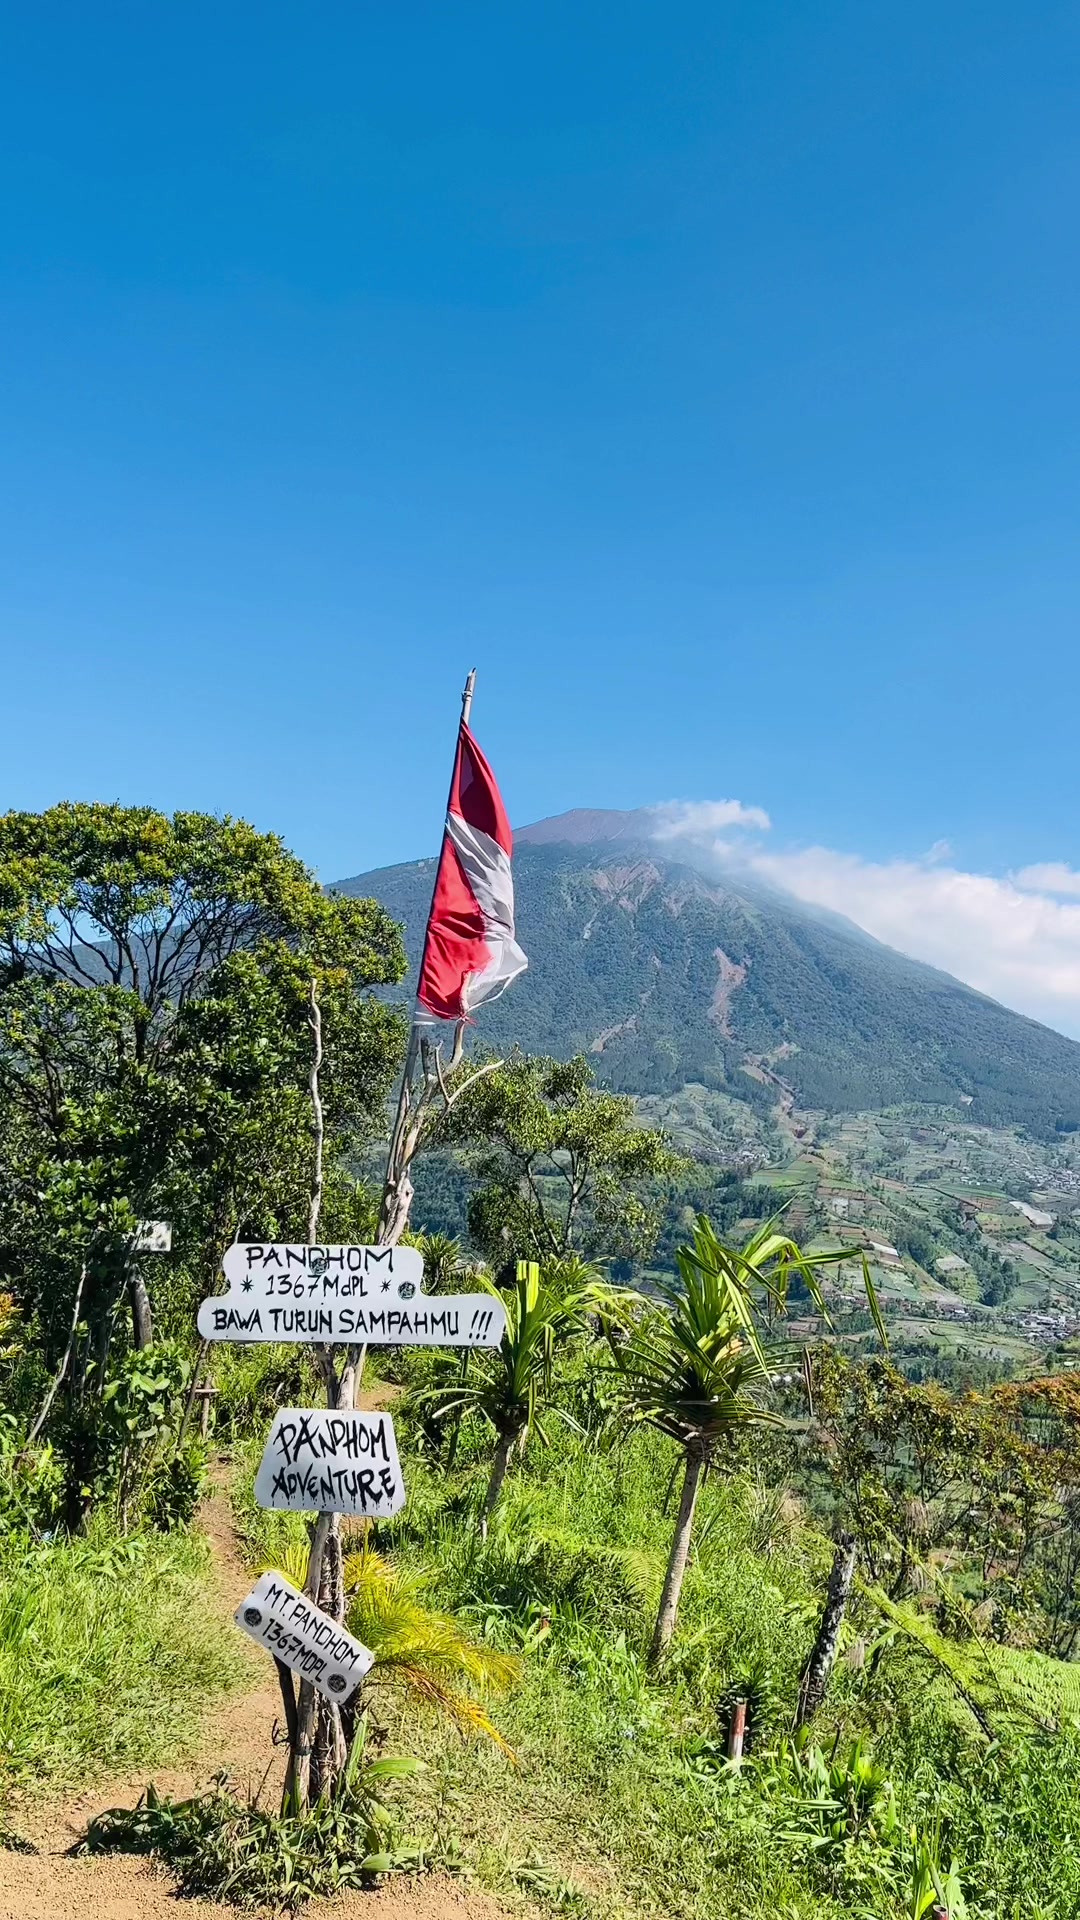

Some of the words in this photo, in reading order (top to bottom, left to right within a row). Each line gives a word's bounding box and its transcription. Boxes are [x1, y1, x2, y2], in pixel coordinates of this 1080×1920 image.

[245, 1246, 394, 1273] PANDHOM
[211, 1308, 263, 1334] BAWA
[268, 1308, 333, 1334] TURUN
[338, 1308, 459, 1336] SAMPAHMU
[272, 1412, 391, 1467] PANDHOM
[270, 1463, 396, 1507] ADVENTURE
